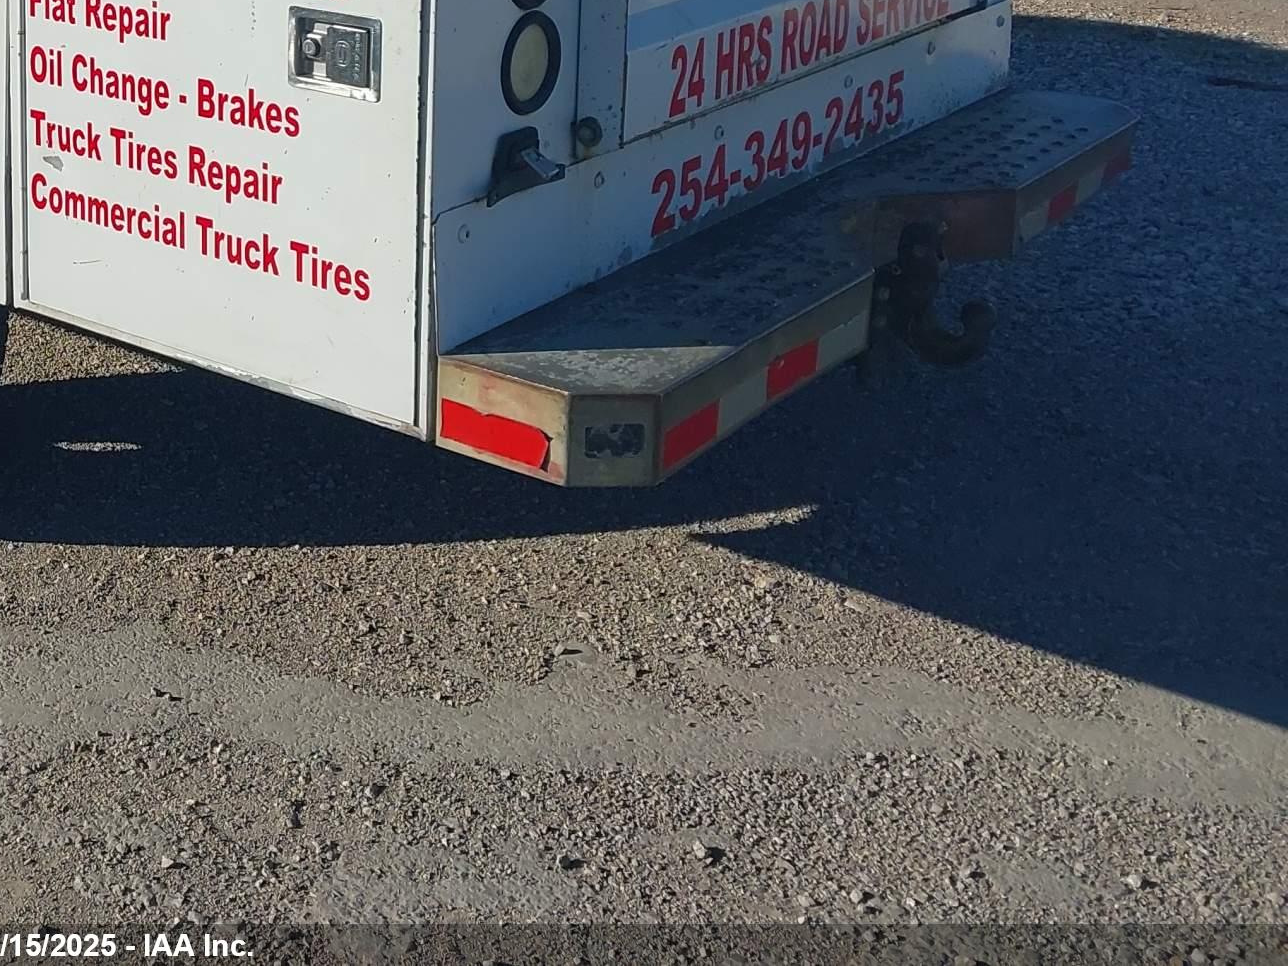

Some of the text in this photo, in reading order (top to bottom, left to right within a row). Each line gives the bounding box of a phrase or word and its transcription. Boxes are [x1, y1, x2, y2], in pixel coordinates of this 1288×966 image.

[30, 45, 300, 138] Oil Change - Brakes
[669, 37, 706, 118] 24
[715, 15, 773, 100] HRS
[30, 109, 283, 204] Truck Tires Repair
[650, 70, 905, 238] 254-349-2435
[31, 172, 372, 302] Commercial Truck Tires
